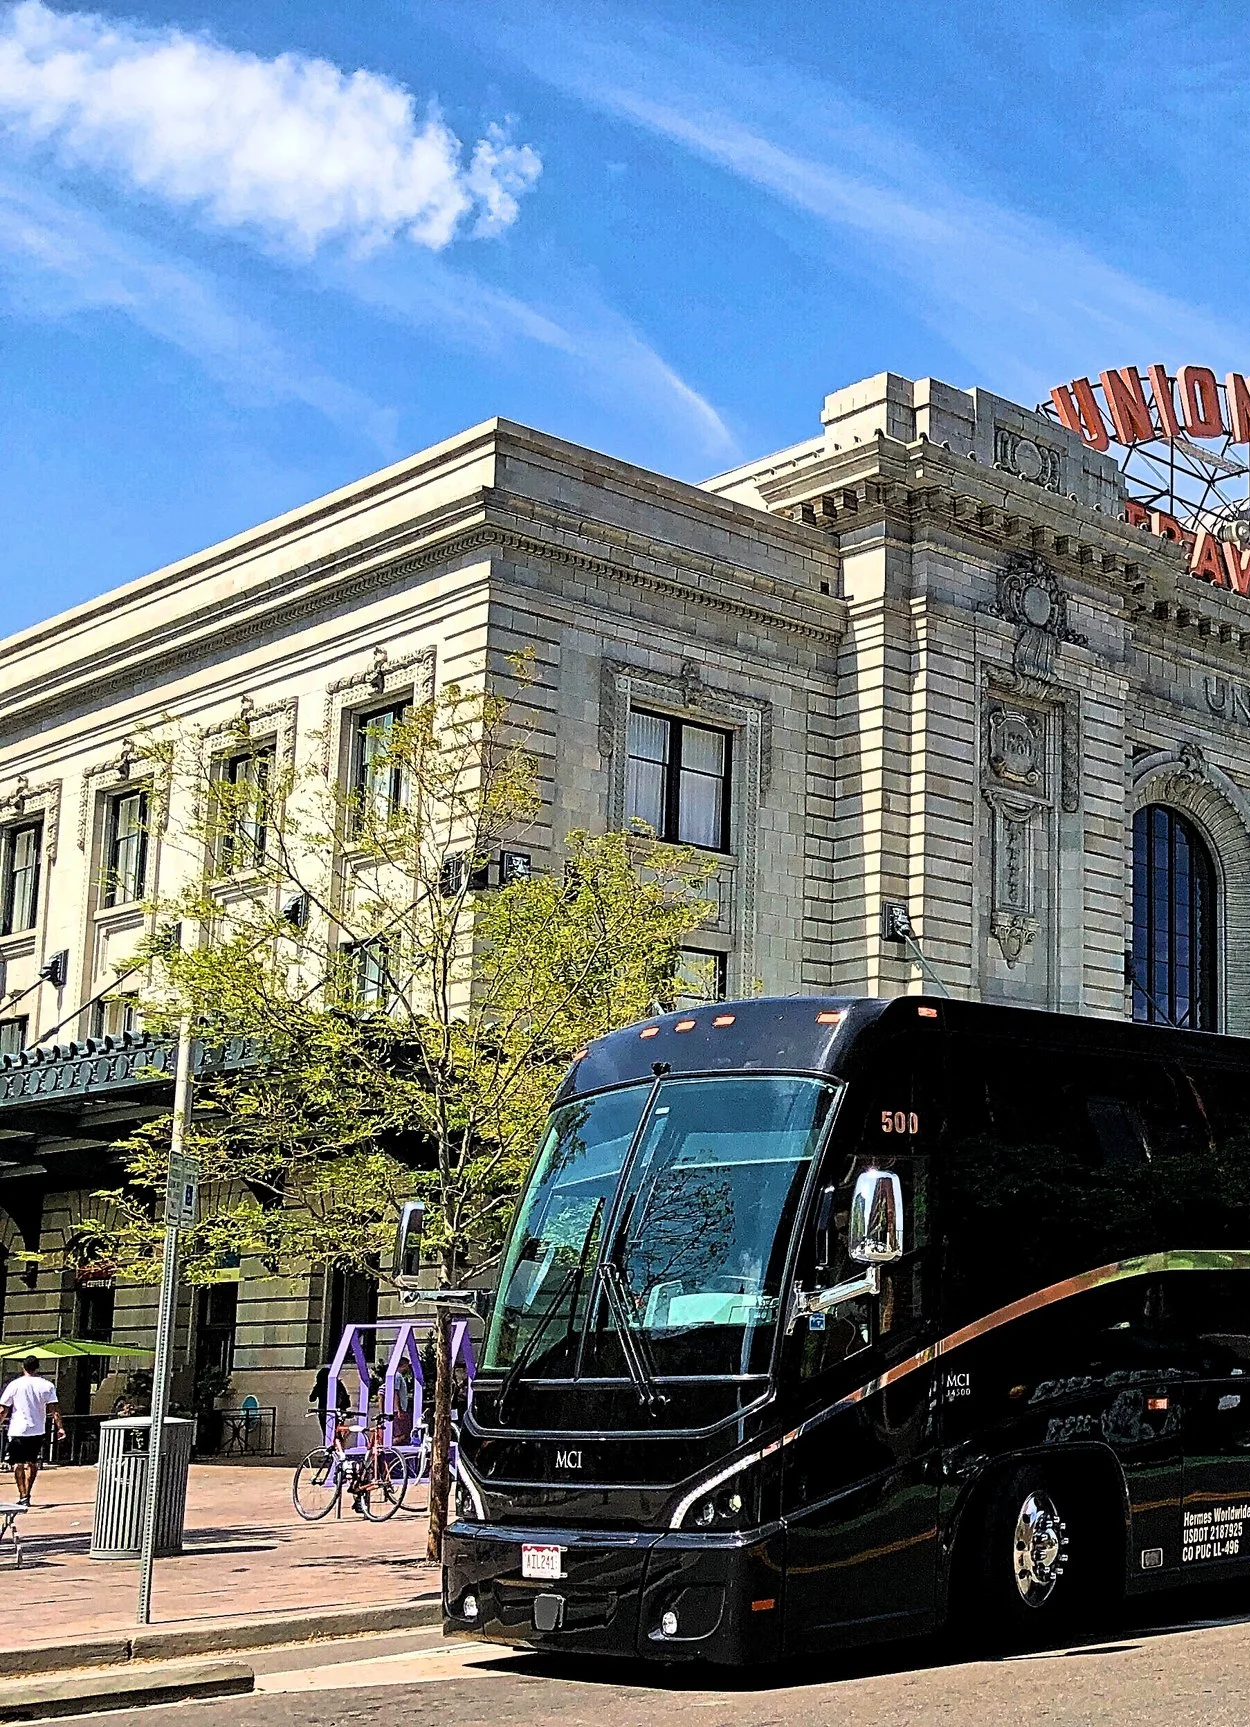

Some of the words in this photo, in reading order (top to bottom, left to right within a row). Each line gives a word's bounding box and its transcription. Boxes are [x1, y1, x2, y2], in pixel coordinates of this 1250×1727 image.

[881, 1110, 919, 1134] 500
[946, 1373, 970, 1388] MCI
[945, 1387, 971, 1398] J4500
[555, 1450, 583, 1469] MCI
[1183, 1511, 1213, 1527] Hermes
[1183, 1526, 1209, 1545] USDOT
[1209, 1522, 1243, 1541] 2187925
[1182, 1546, 1194, 1562] CO
[1195, 1543, 1211, 1560] PUC
[1213, 1539, 1240, 1557] LL-496
